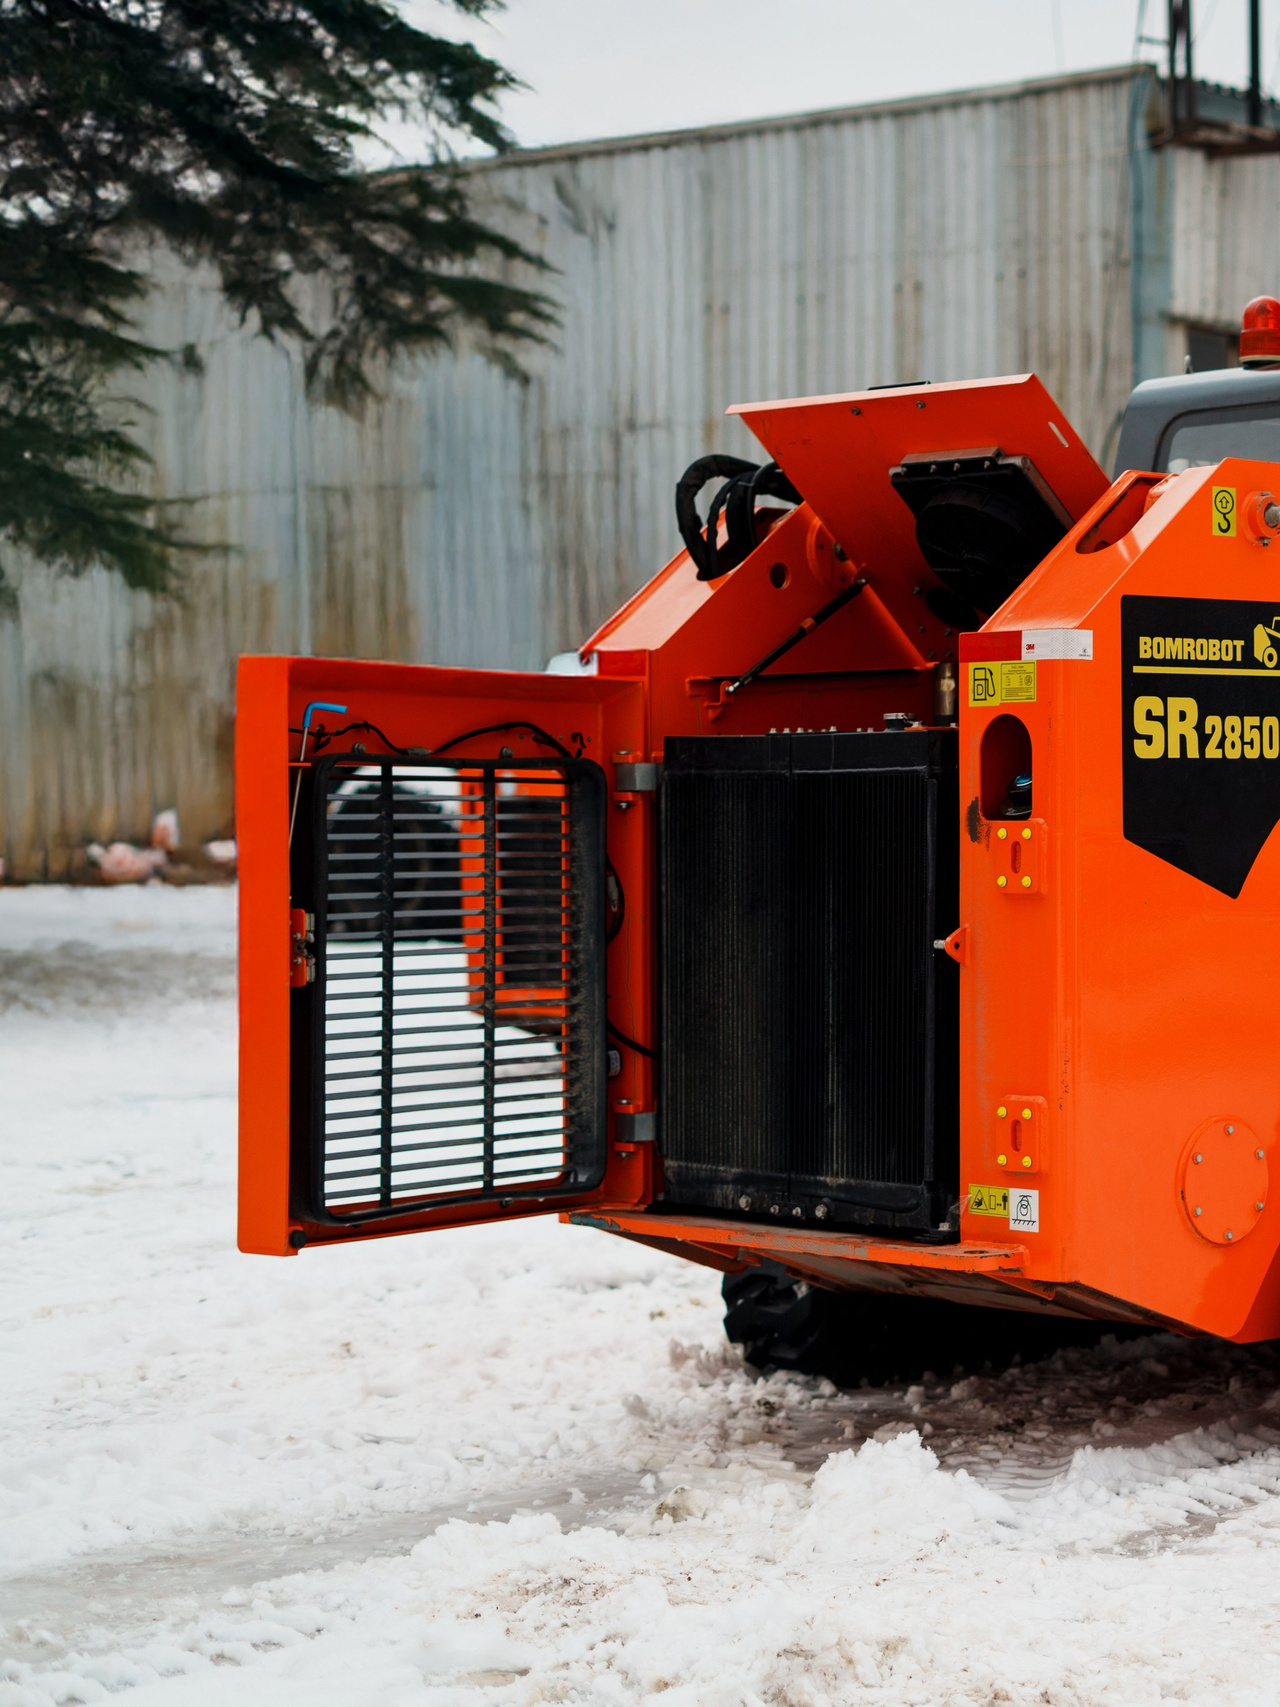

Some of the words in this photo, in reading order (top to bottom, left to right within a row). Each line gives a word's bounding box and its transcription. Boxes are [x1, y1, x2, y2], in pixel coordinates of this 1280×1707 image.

[1025, 643, 1035, 651] 3M
[1139, 636, 1244, 661] BOMROBOT
[1133, 695, 1200, 759] SR
